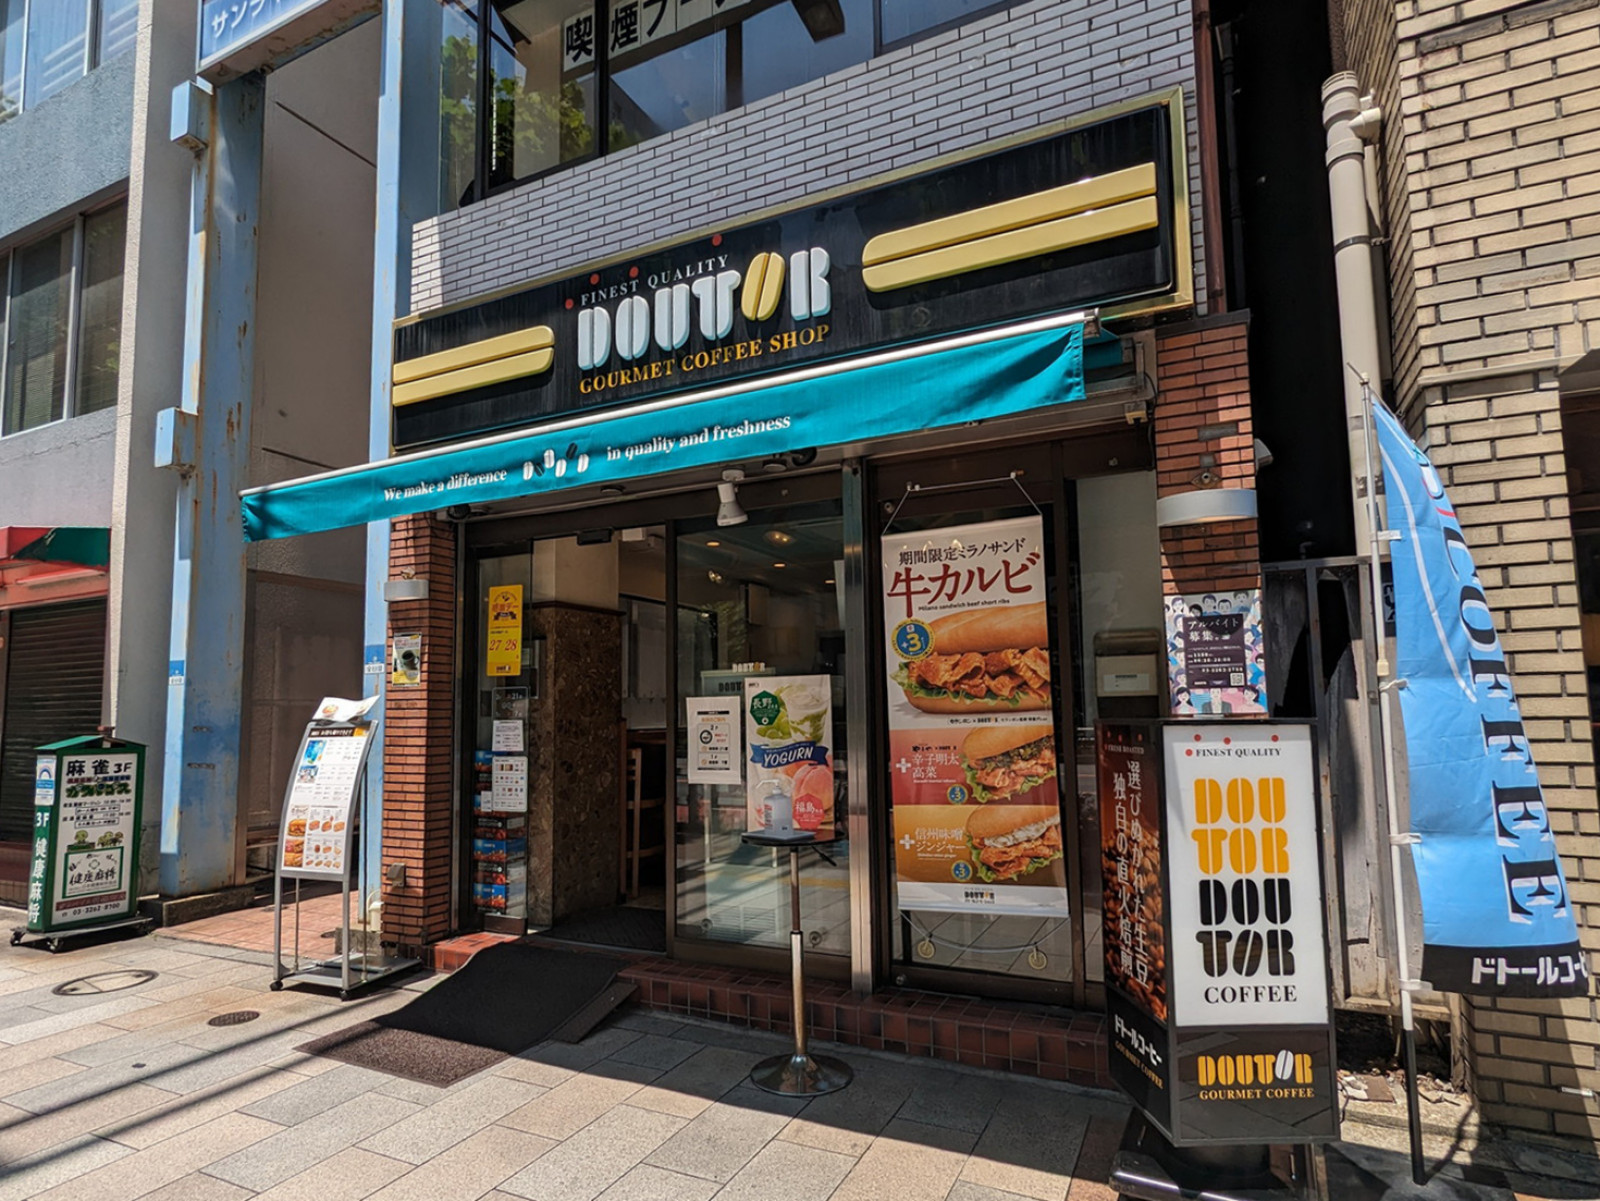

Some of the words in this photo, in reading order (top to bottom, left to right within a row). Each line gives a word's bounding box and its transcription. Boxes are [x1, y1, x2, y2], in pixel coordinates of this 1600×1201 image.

[580, 279, 640, 306] FINEST
[647, 254, 729, 289] QUALITY
[577, 247, 831, 371] DOUTOR
[579, 359, 675, 394] GOURMET
[681, 339, 763, 372] COFFEE
[769, 324, 830, 354] SHOP
[384, 487, 403, 501] We
[404, 481, 435, 498] make
[436, 481, 445, 492] a
[446, 469, 507, 490] difference
[607, 446, 621, 461] in
[625, 436, 676, 460] quality
[679, 428, 709, 448] and
[712, 416, 791, 441] freshness
[899, 537, 1026, 566] 期間限定ミラノサンド
[887, 551, 1041, 618] 牛カルビ
[1187, 618, 1239, 630] アルバイト
[65, 759, 110, 776] 麻雀
[113, 762, 133, 774] 3F
[764, 746, 814, 767] YOGURN
[912, 753, 959, 766] 辛子明太
[1196, 748, 1232, 757] FINEST
[1235, 748, 1282, 758] QUALITY
[35, 812, 50, 828] 3F
[1193, 777, 1286, 824] DOU
[1190, 828, 1290, 874] TOR
[1113, 772, 1135, 978] 独自の直火焙煎
[1126, 760, 1150, 990] 選びぬかれた生豆
[1198, 878, 1292, 926] DOU
[1195, 929, 1296, 978] TOR
[1204, 985, 1297, 1004] COFFEE
[1114, 1013, 1163, 1067] ドトールコーヒー
[1197, 1049, 1313, 1087] DOUTOR
[1199, 1089, 1262, 1100] GOURMET
[1265, 1087, 1315, 1098] COFFEE
